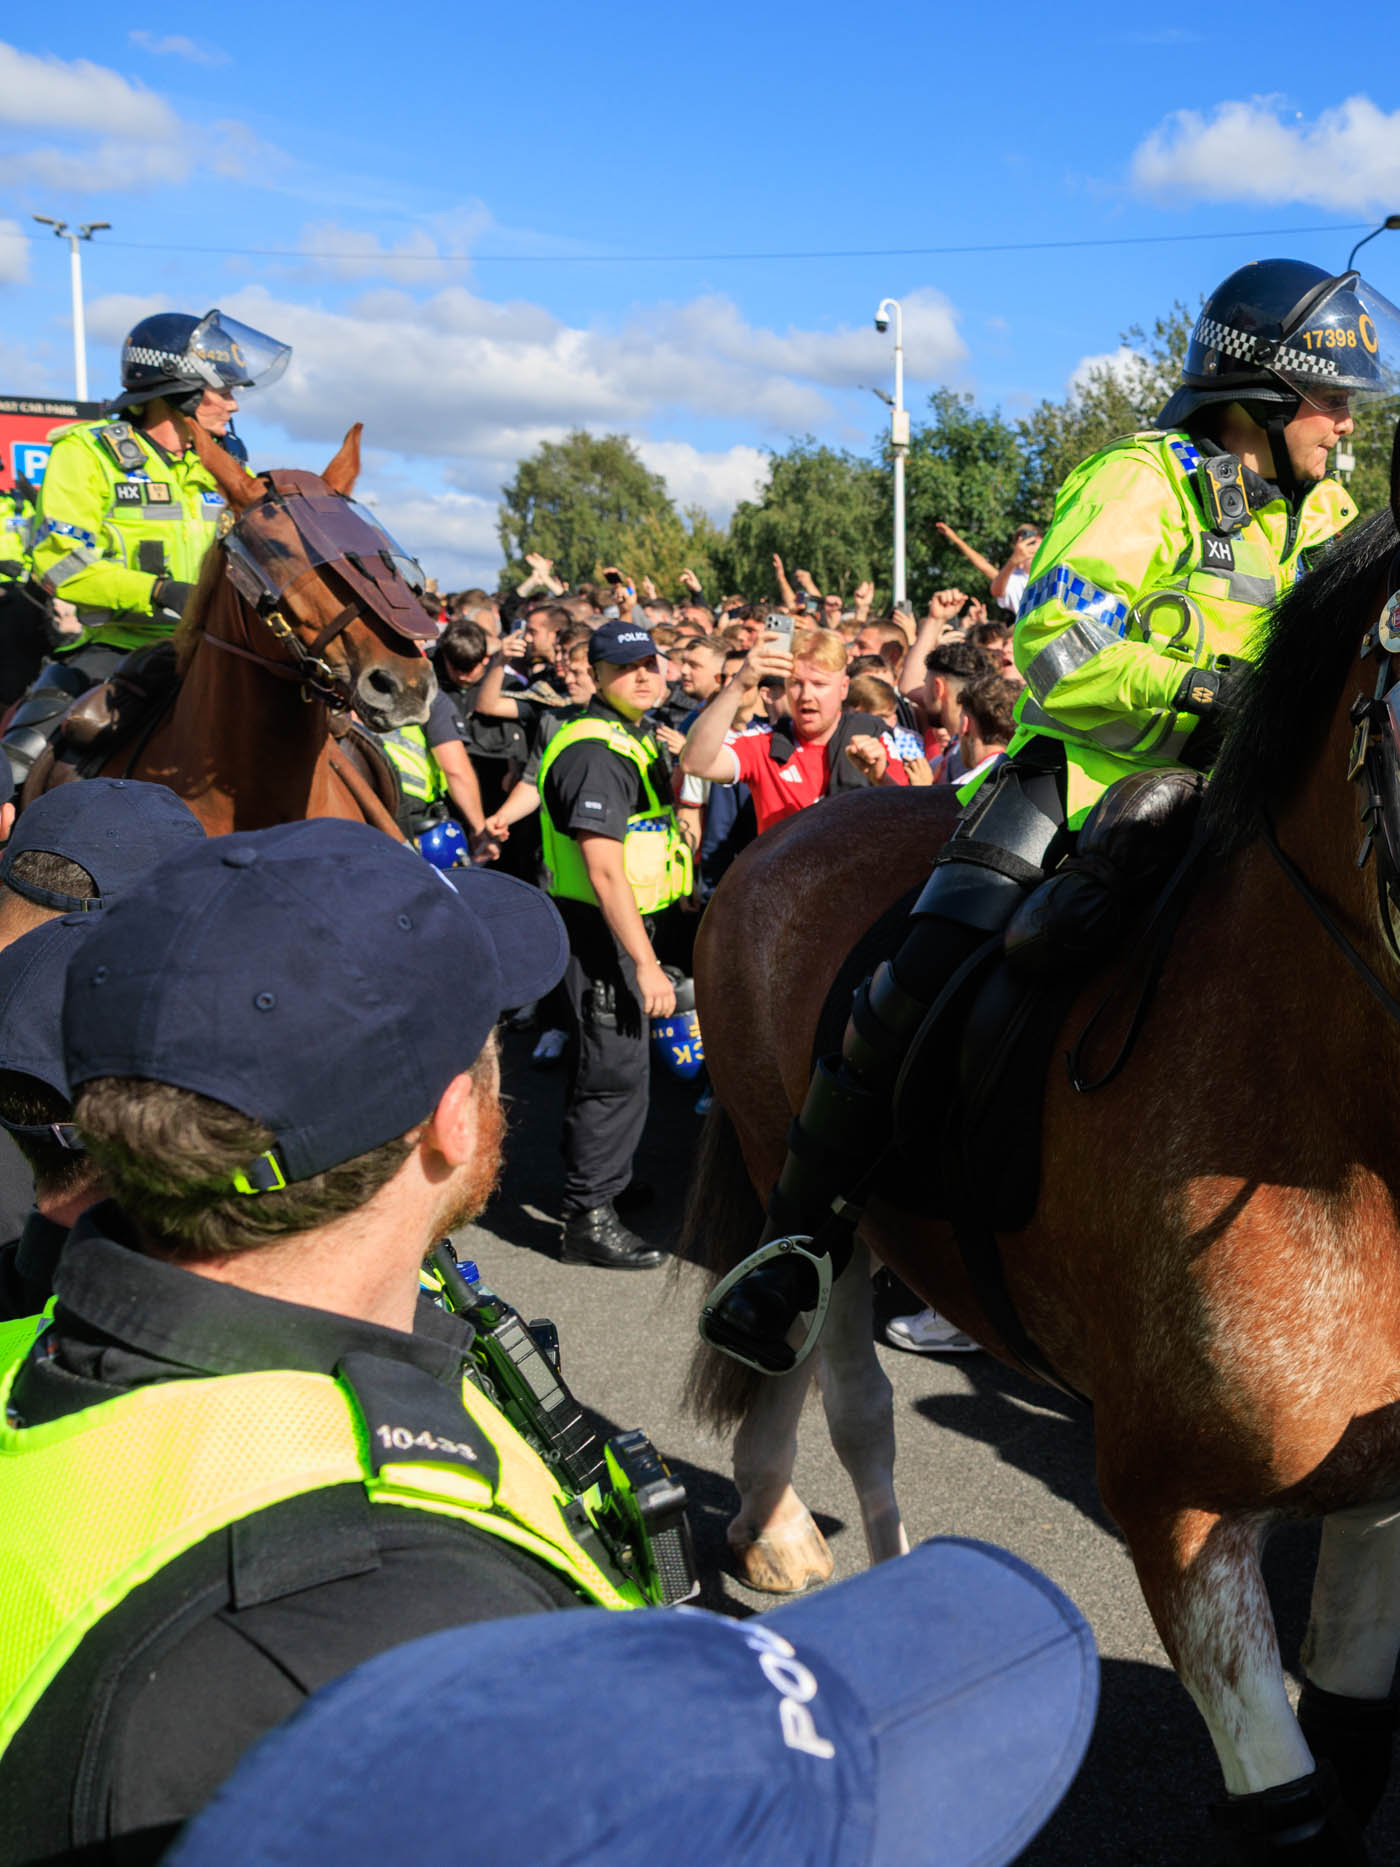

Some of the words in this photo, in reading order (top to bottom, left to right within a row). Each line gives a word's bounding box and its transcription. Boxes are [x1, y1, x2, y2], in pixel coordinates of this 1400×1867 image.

[1303, 328, 1357, 350] 17398
[1359, 313, 1378, 353] C
[24, 449, 48, 480] P
[117, 486, 139, 500] HX
[1206, 539, 1232, 561] XH
[617, 631, 650, 644] POLICE
